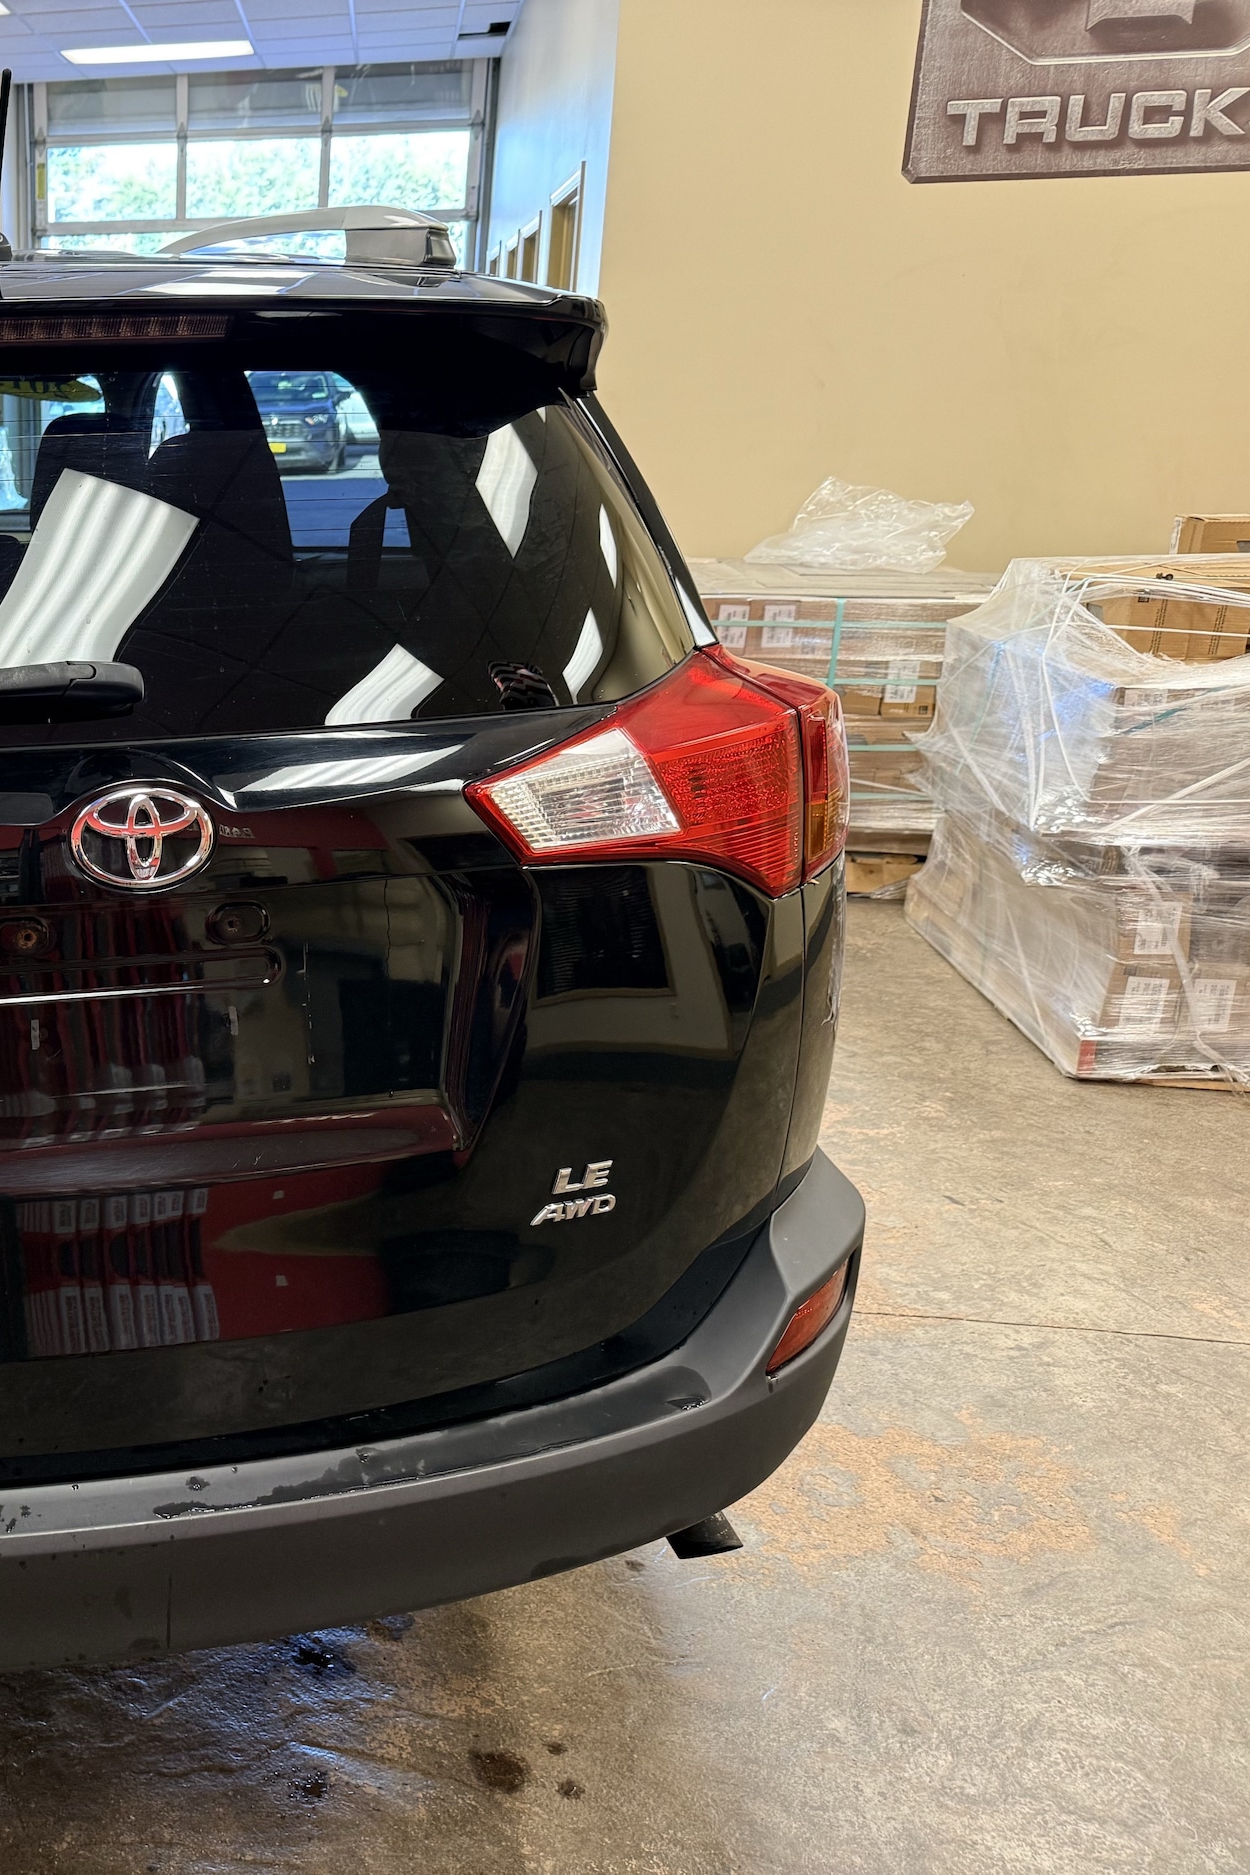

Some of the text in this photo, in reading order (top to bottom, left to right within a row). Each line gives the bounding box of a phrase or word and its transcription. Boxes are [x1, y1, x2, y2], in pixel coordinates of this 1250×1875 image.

[946, 86, 1250, 147] TRUCK
[551, 1160, 613, 1195] LE
[530, 1193, 616, 1226] AWD
